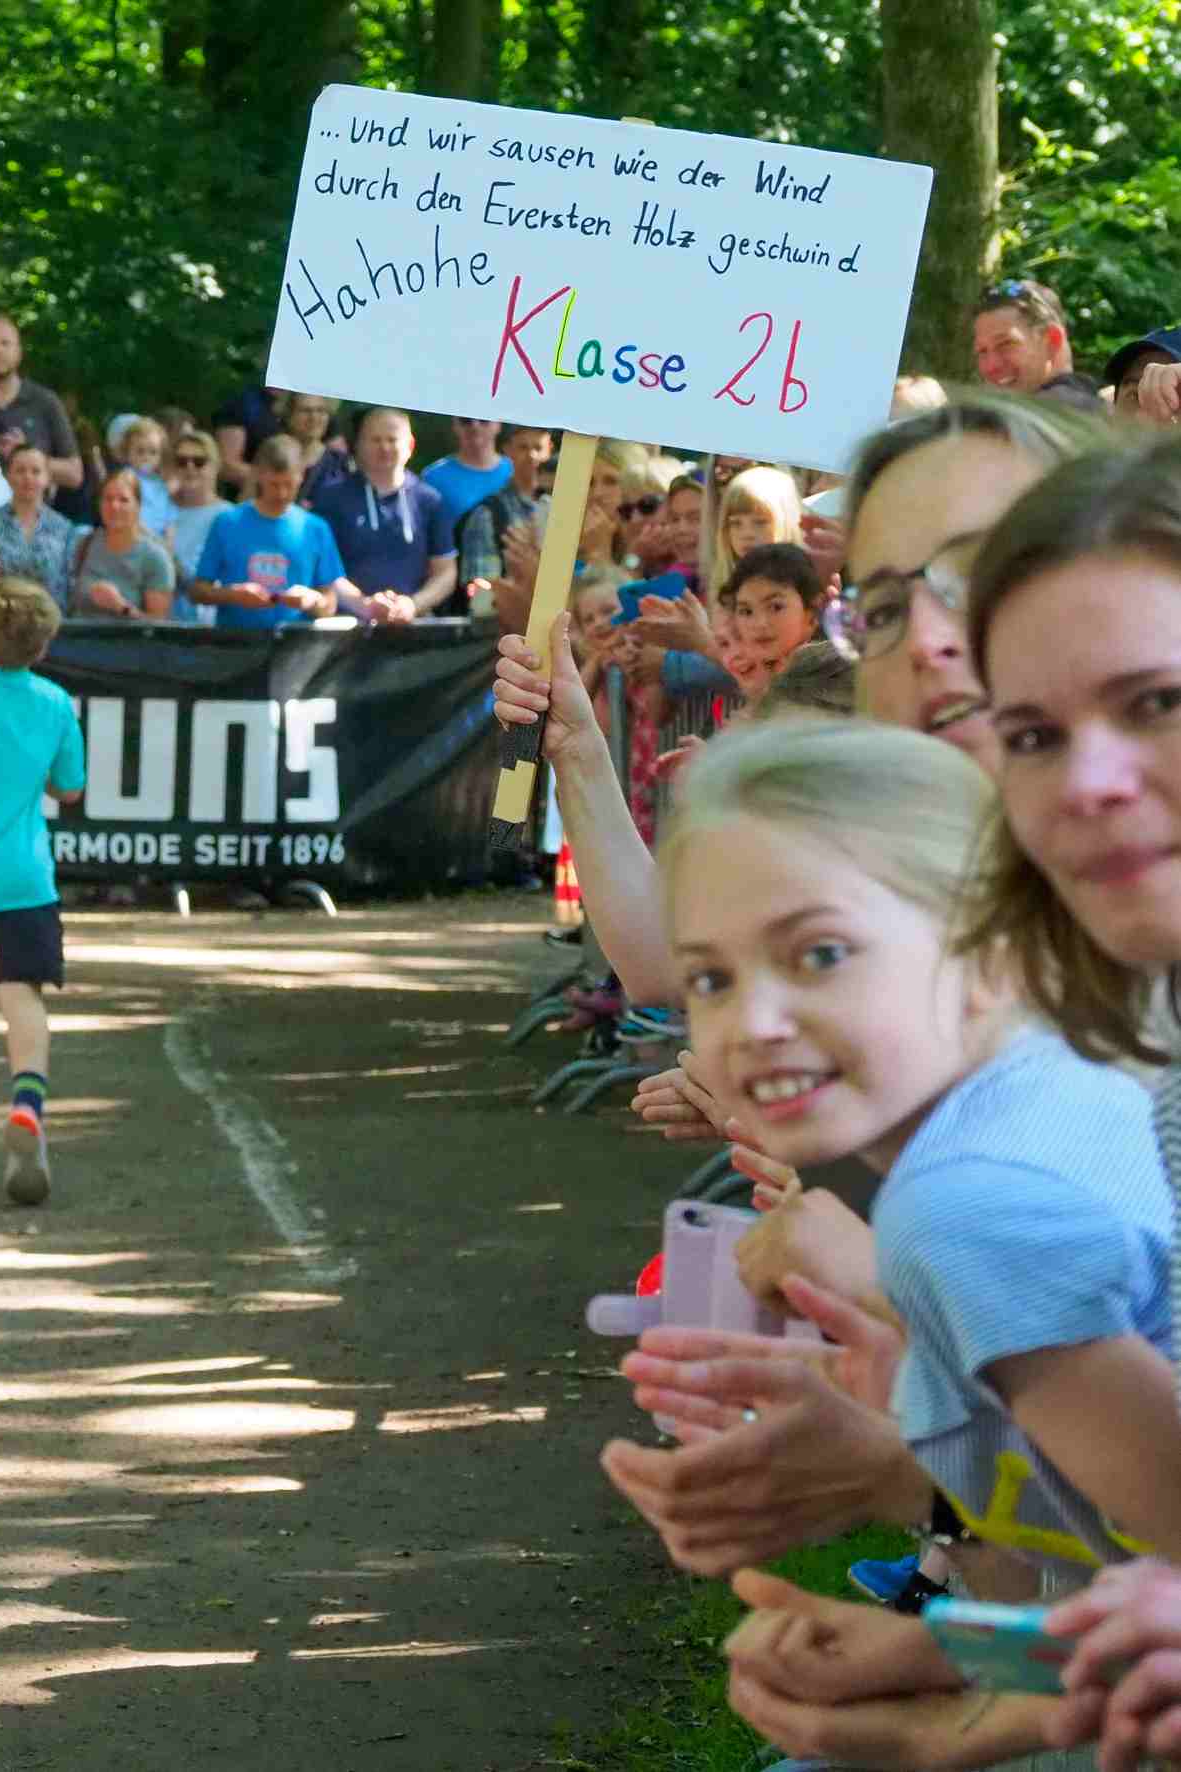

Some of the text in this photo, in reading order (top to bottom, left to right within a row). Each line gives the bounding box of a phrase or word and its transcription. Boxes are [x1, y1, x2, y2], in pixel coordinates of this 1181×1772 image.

[428, 121, 476, 152] wir
[488, 137, 596, 170] sausen
[613, 149, 658, 182] wie
[677, 159, 726, 188] der
[754, 159, 832, 204] Wind
[314, 159, 861, 274] durch den Eversten Holz geschwind
[286, 223, 495, 341] Hahohe
[713, 311, 810, 414] 2b
[194, 836, 273, 866] SEIT
[278, 833, 346, 864] 1896
